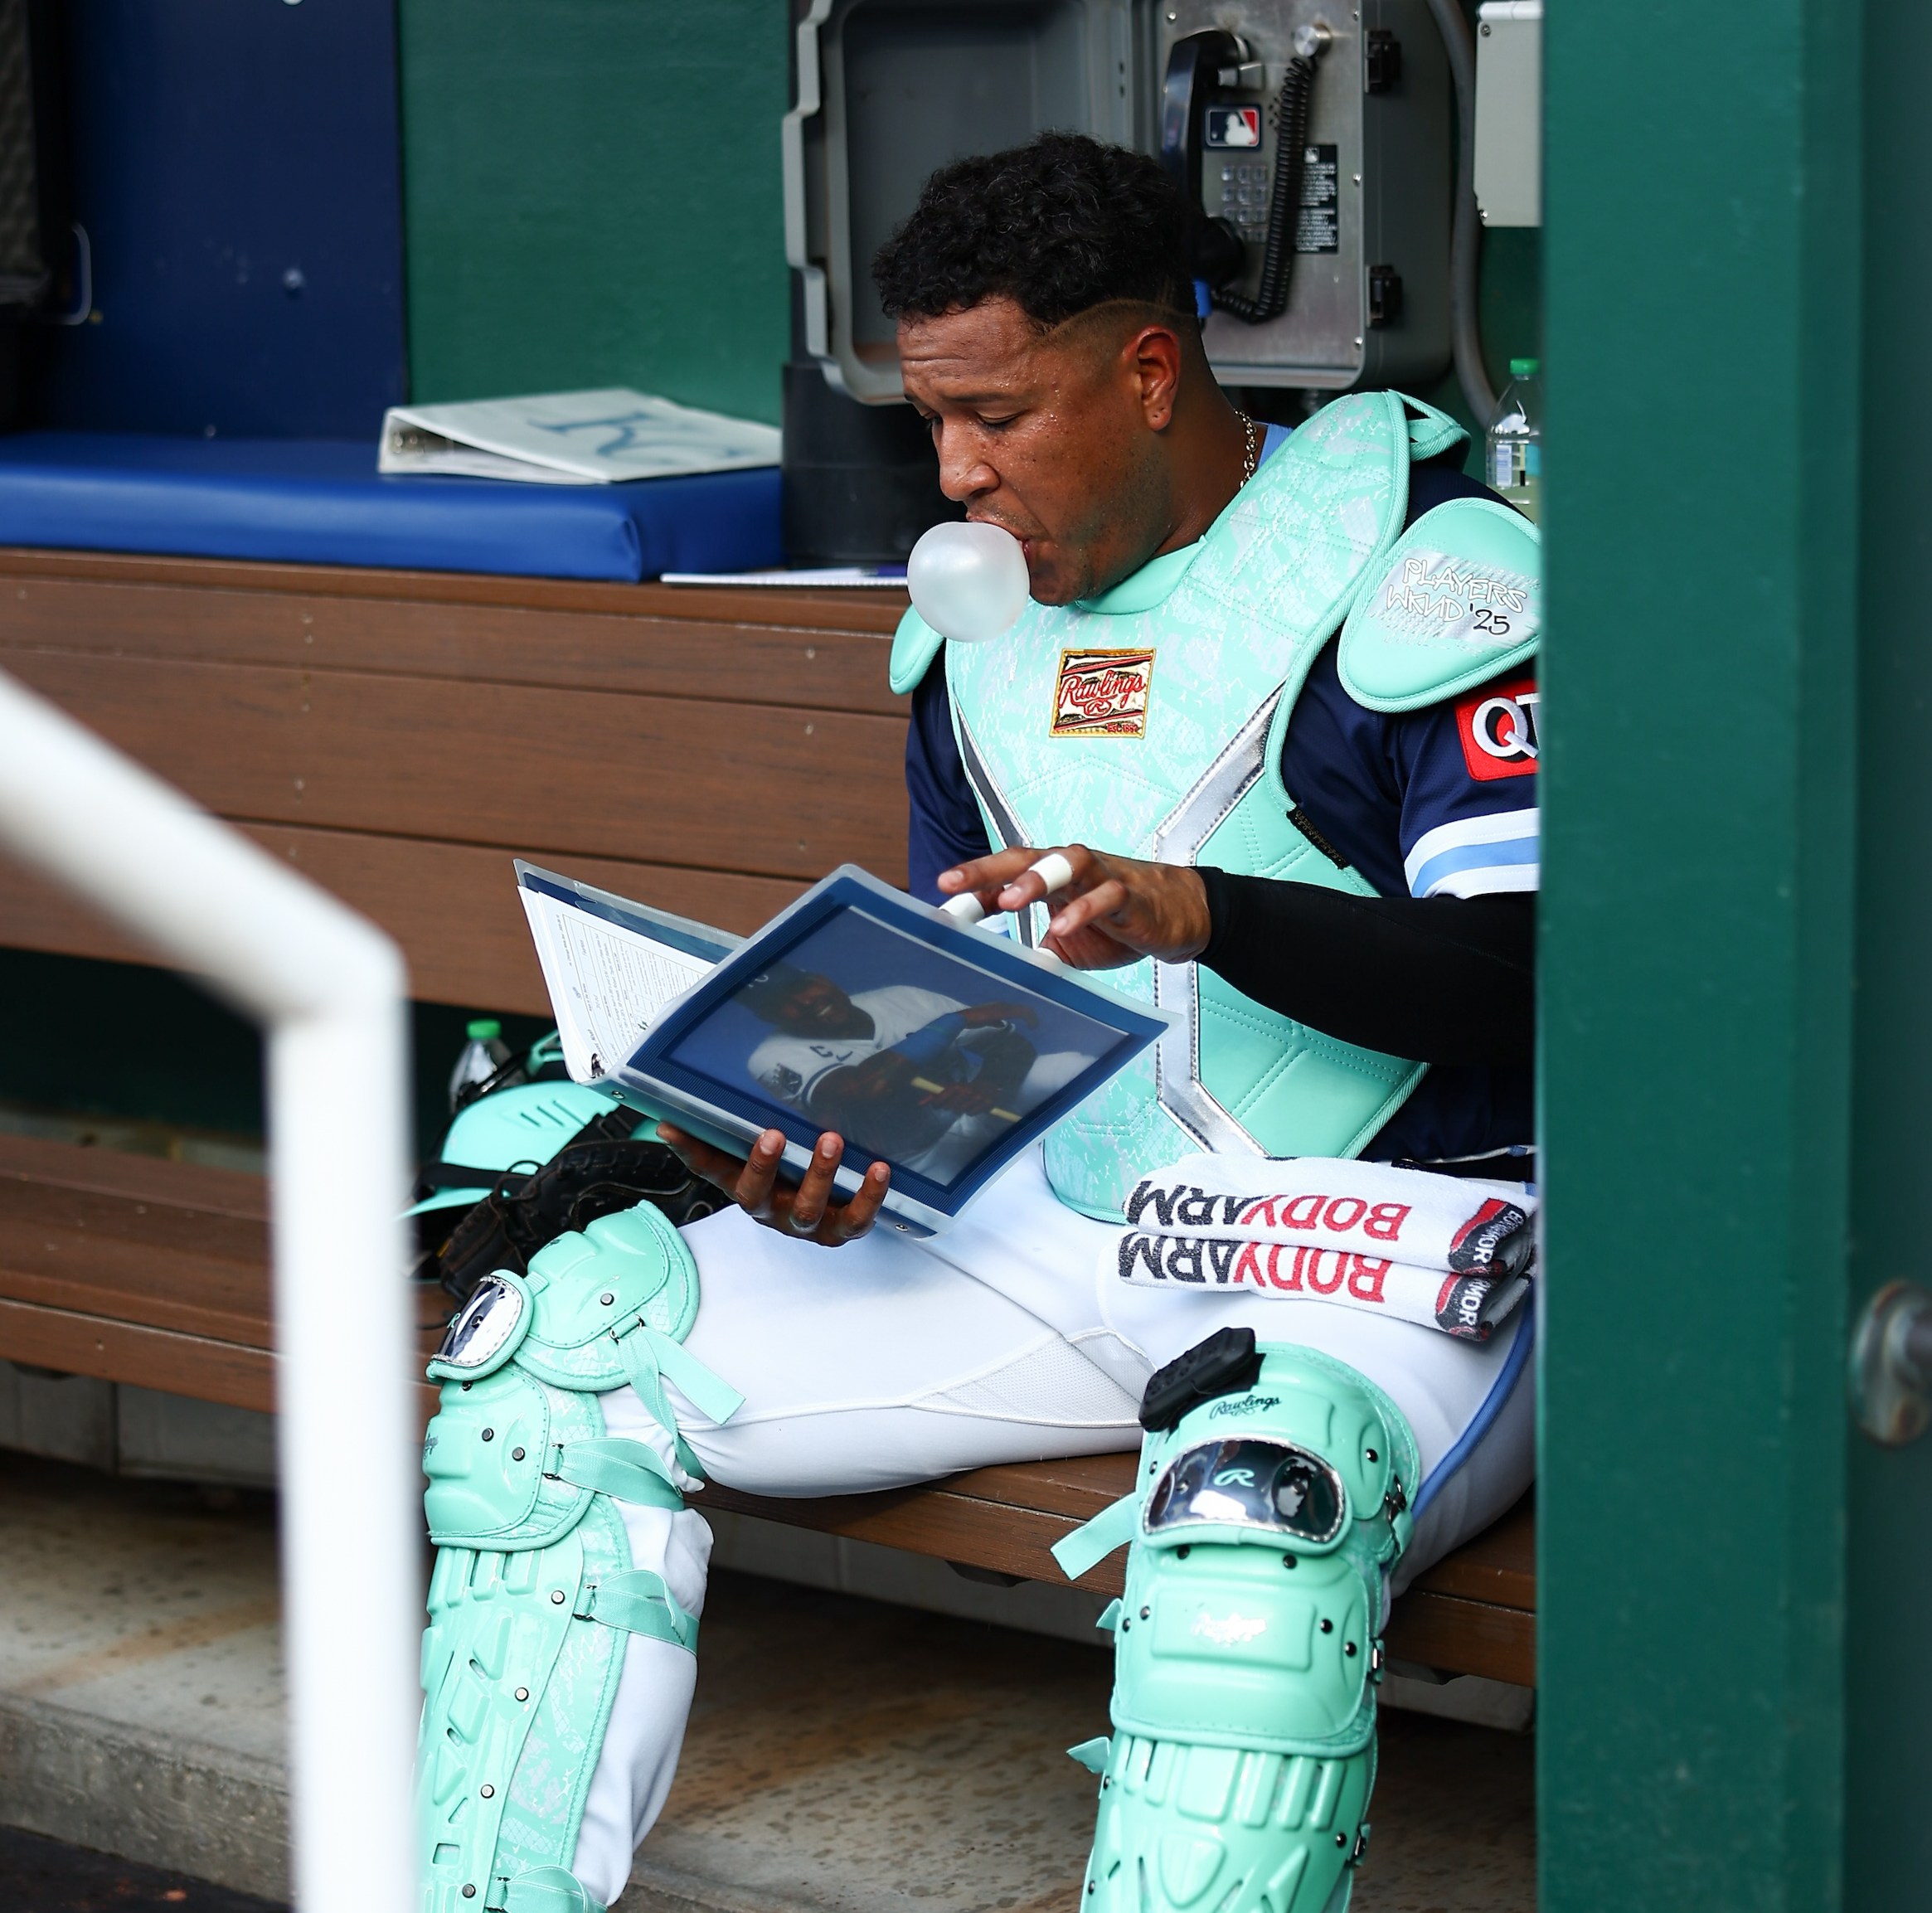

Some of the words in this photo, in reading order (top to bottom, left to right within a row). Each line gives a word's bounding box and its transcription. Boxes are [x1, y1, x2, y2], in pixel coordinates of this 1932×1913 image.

[1402, 557, 1527, 614] PLAYERS
[1386, 585, 1464, 623] WKND
[1470, 603, 1511, 635] '25
[1057, 669, 1147, 709] Rawlings
[1209, 1395, 1282, 1420] Rawlings
